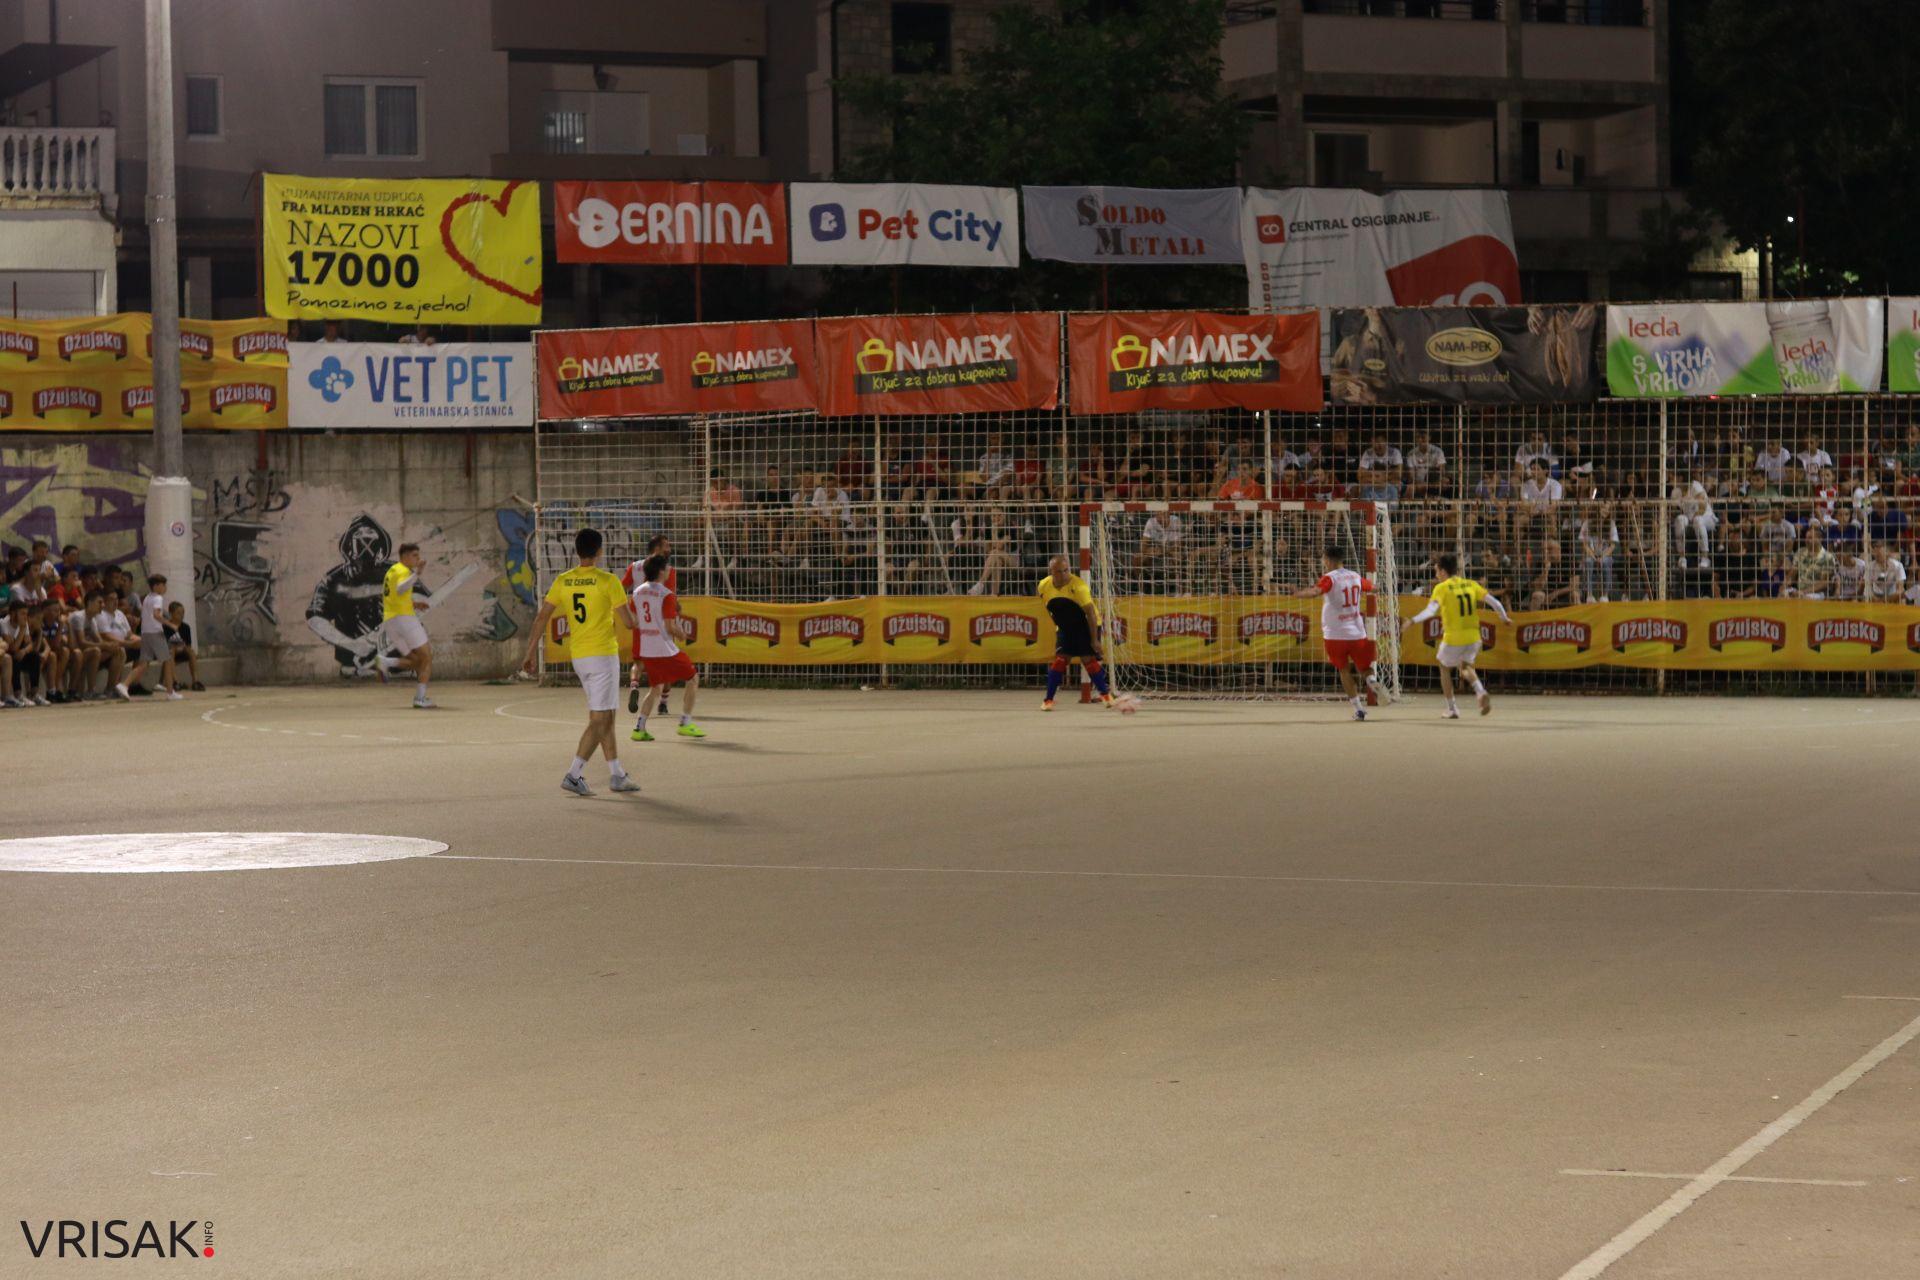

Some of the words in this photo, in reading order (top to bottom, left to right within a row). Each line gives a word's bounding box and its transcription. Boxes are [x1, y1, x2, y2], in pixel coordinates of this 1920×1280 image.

[282, 201, 307, 213] FRA
[311, 204, 370, 216] MLADEN
[374, 204, 425, 217] HRKAĆ
[1076, 193, 1166, 226] SOLDO
[568, 198, 773, 248] BERNINA
[858, 208, 919, 240] Pet
[928, 208, 1002, 251] City
[1289, 218, 1348, 233] CENTRAL
[1351, 211, 1431, 228] OSIGURANJE
[287, 219, 419, 250] NAZOVI
[1094, 225, 1205, 255] METALI
[287, 250, 419, 288] 17000
[287, 290, 387, 310] Pomozimo
[393, 295, 471, 319] zajedno!
[1628, 316, 1681, 338] leda
[65, 333, 121, 352] Ožujsko
[895, 333, 1013, 371] NAMEX
[1150, 333, 1274, 367] NAMEX
[1434, 341, 1493, 353] NAM-PEK
[582, 352, 660, 379] NAMEX
[715, 346, 795, 373] NAMEX
[1632, 354, 1647, 375] S
[1654, 346, 1718, 373] VRHA
[365, 355, 437, 403] VET
[446, 355, 513, 403] PET
[904, 377, 923, 387] za
[926, 370, 956, 384] dobru
[1157, 372, 1177, 383] za
[1180, 366, 1209, 383] dobru
[1211, 361, 1263, 382] kupovinu!
[1633, 364, 1721, 395] VRHOVA
[38, 388, 97, 408] Ožujsko
[216, 384, 272, 405] Ožujsko
[394, 406, 469, 418] VETERINARSKA
[473, 405, 514, 417] STANICA
[1341, 585, 1360, 608] 10
[1456, 593, 1473, 617] 11
[572, 593, 587, 624] 5
[642, 601, 652, 623] 3
[720, 615, 775, 637] Ožujsko
[804, 615, 859, 638] Ožujsko
[888, 613, 945, 636] Ožujsko
[975, 613, 1033, 636] Ožujsko
[1523, 619, 1585, 642] Ožujsko
[1618, 618, 1682, 643] Ožujsko
[1715, 618, 1779, 641] Ožujsko
[1814, 619, 1879, 642] Ožujsko
